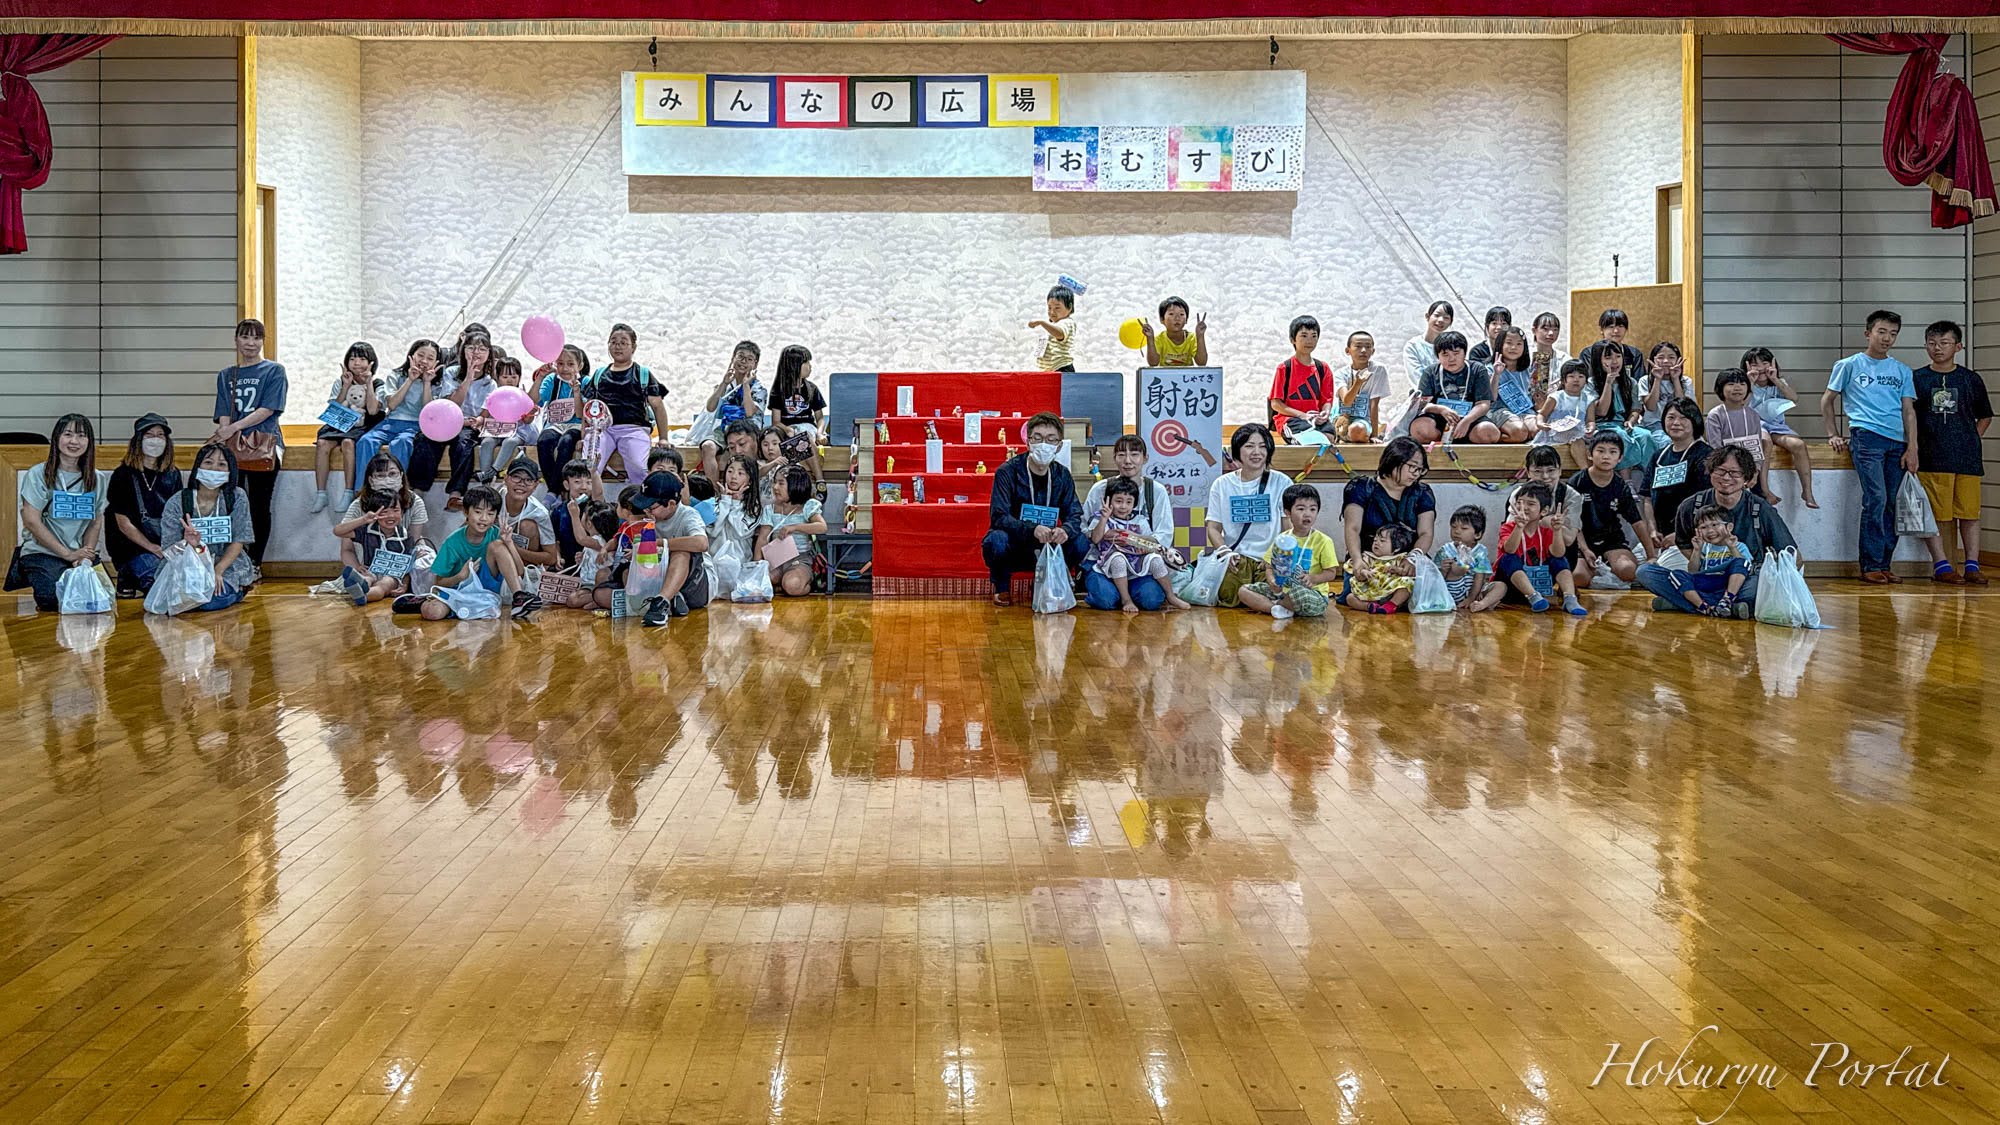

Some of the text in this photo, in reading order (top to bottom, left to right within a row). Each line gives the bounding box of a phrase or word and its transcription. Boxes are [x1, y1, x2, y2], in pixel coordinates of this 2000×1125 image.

[659, 87, 1036, 113] みんなの広場
[1046, 146, 1286, 174] 「おむすび」
[1183, 374, 1214, 384] しゃてき
[1145, 377, 1218, 418] 射的
